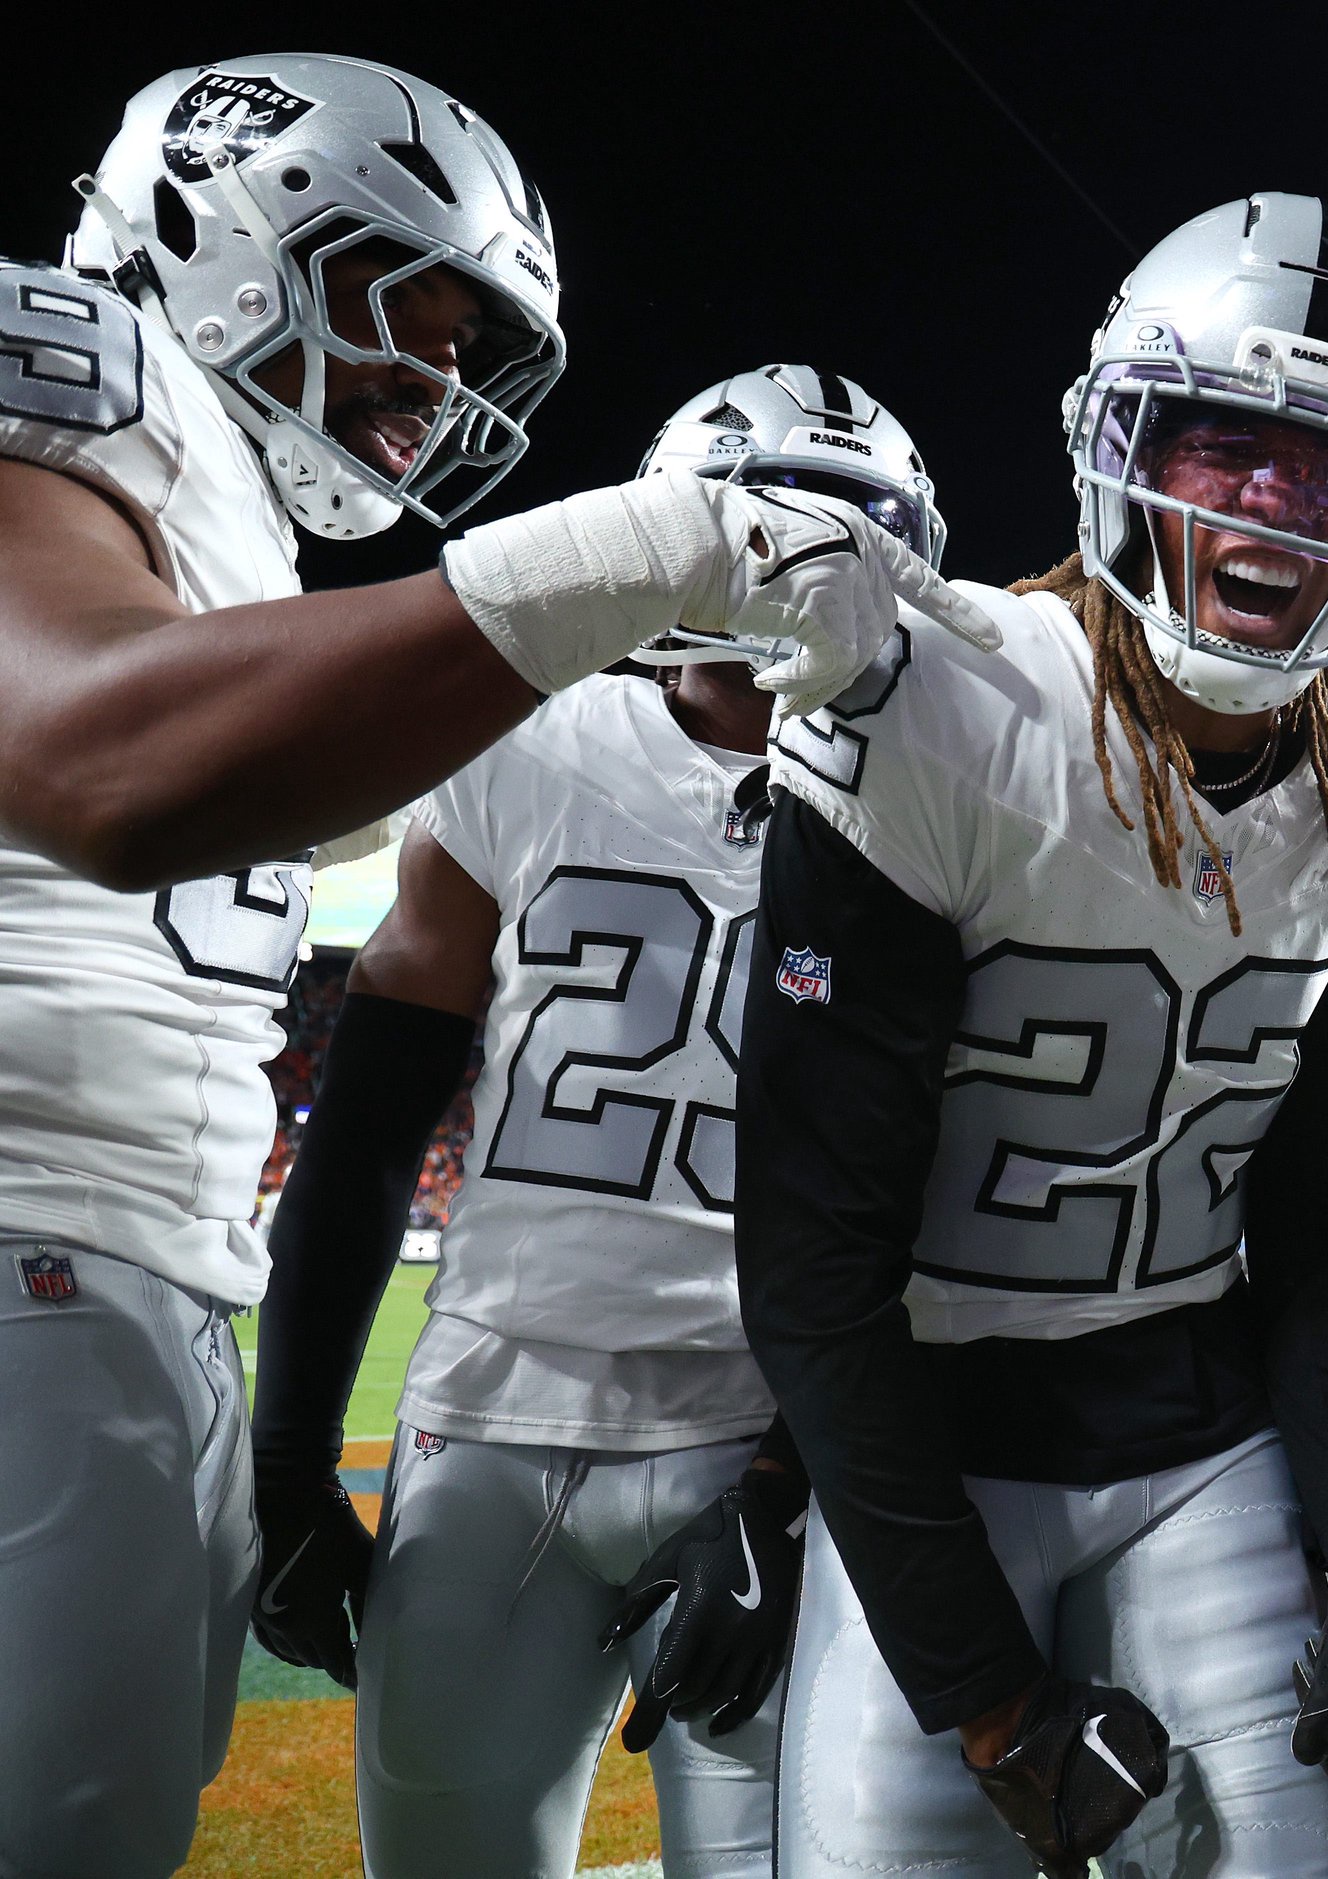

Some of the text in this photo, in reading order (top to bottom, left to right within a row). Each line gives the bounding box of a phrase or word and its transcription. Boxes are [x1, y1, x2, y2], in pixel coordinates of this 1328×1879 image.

[206, 76, 299, 110] RAIDERS
[515, 249, 554, 296] RAIDE
[810, 432, 872, 457] RAIDERS
[780, 970, 822, 1002] NFL
[480, 865, 762, 1213] 2
[31, 1274, 75, 1298] NFL
